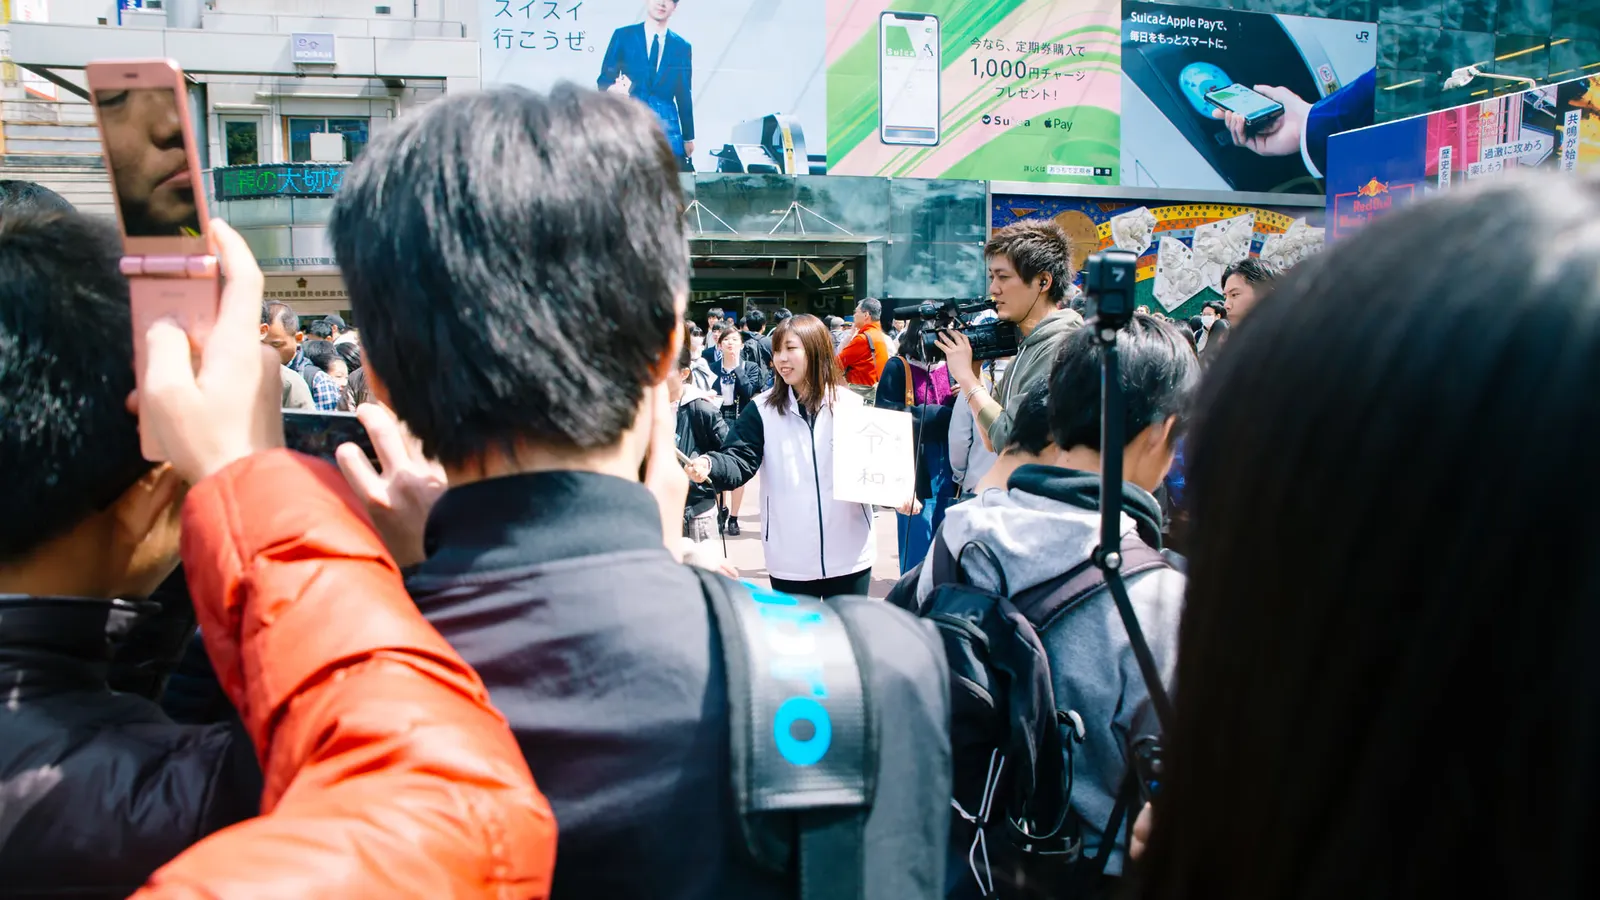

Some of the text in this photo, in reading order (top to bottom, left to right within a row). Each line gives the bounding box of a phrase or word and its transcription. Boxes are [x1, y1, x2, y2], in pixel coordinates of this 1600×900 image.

[495, 0, 583, 20] スイスイ
[493, 28, 594, 52] 行こうぜ。
[1130, 30, 1227, 50] 毎日をもっとスマートに。
[1053, 118, 1073, 132] Pay
